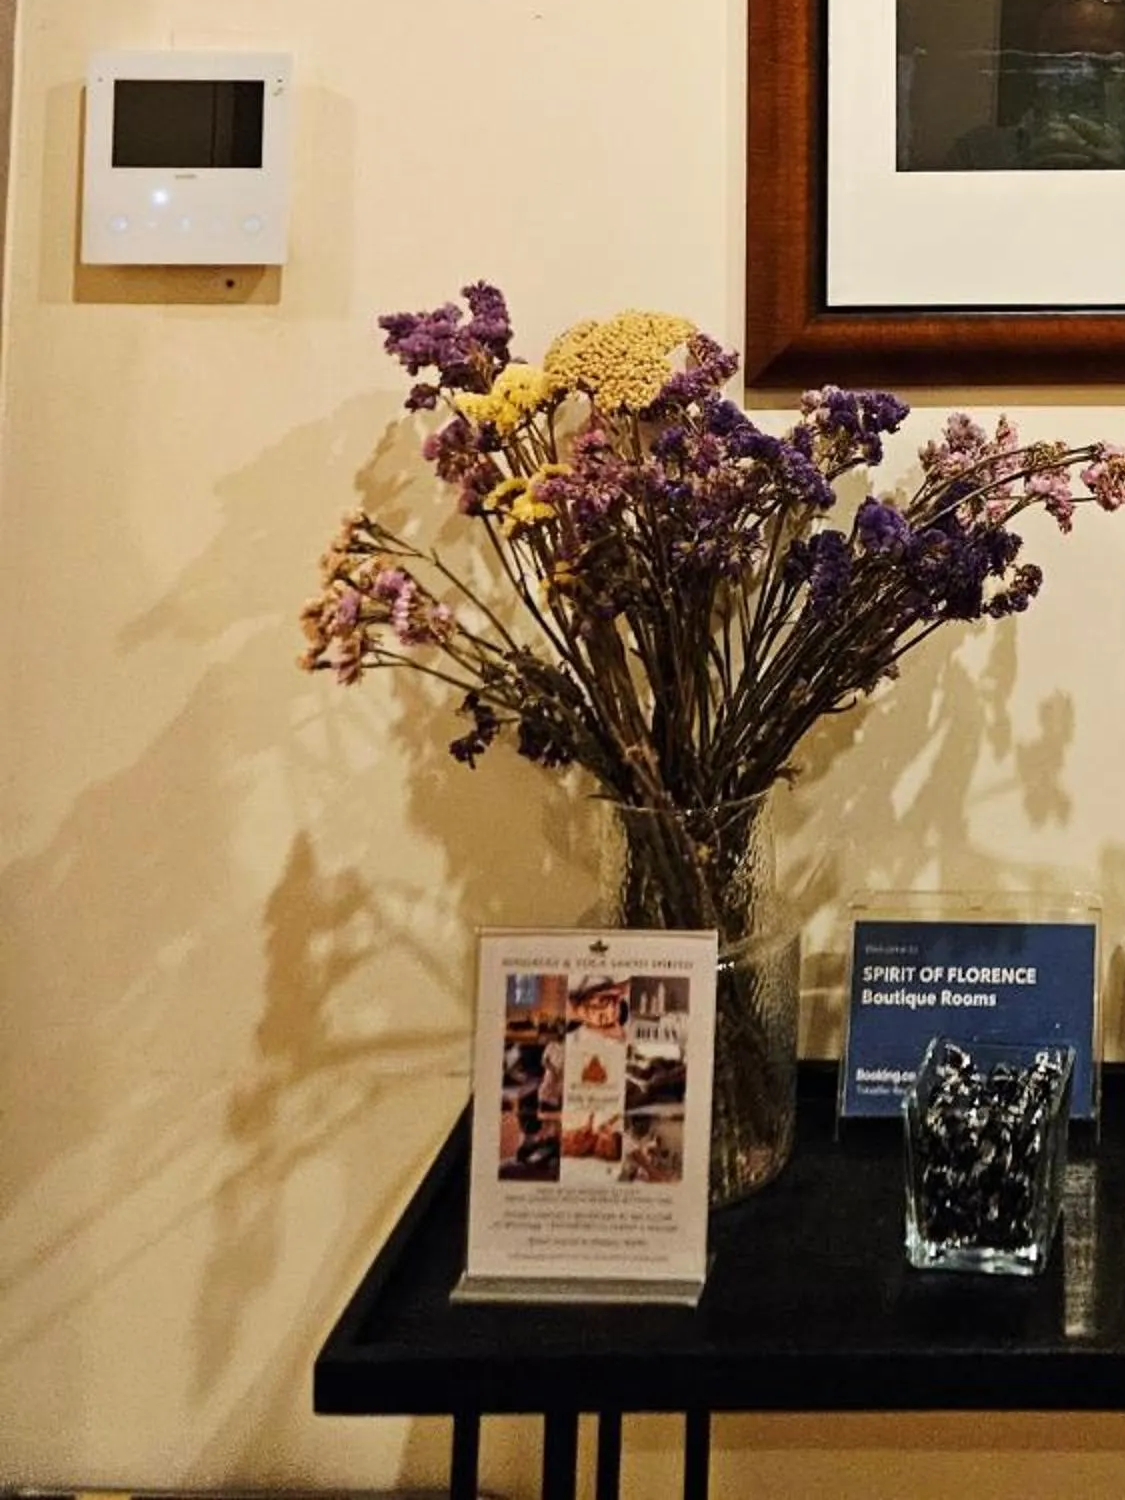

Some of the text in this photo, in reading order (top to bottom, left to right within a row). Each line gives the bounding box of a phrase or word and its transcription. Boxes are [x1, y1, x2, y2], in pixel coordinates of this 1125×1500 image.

[863, 966, 1037, 985] SPIRIT OF FLORENCE
[861, 988, 997, 1009] Boutique Rooms
[857, 1067, 917, 1084] Booking.co
